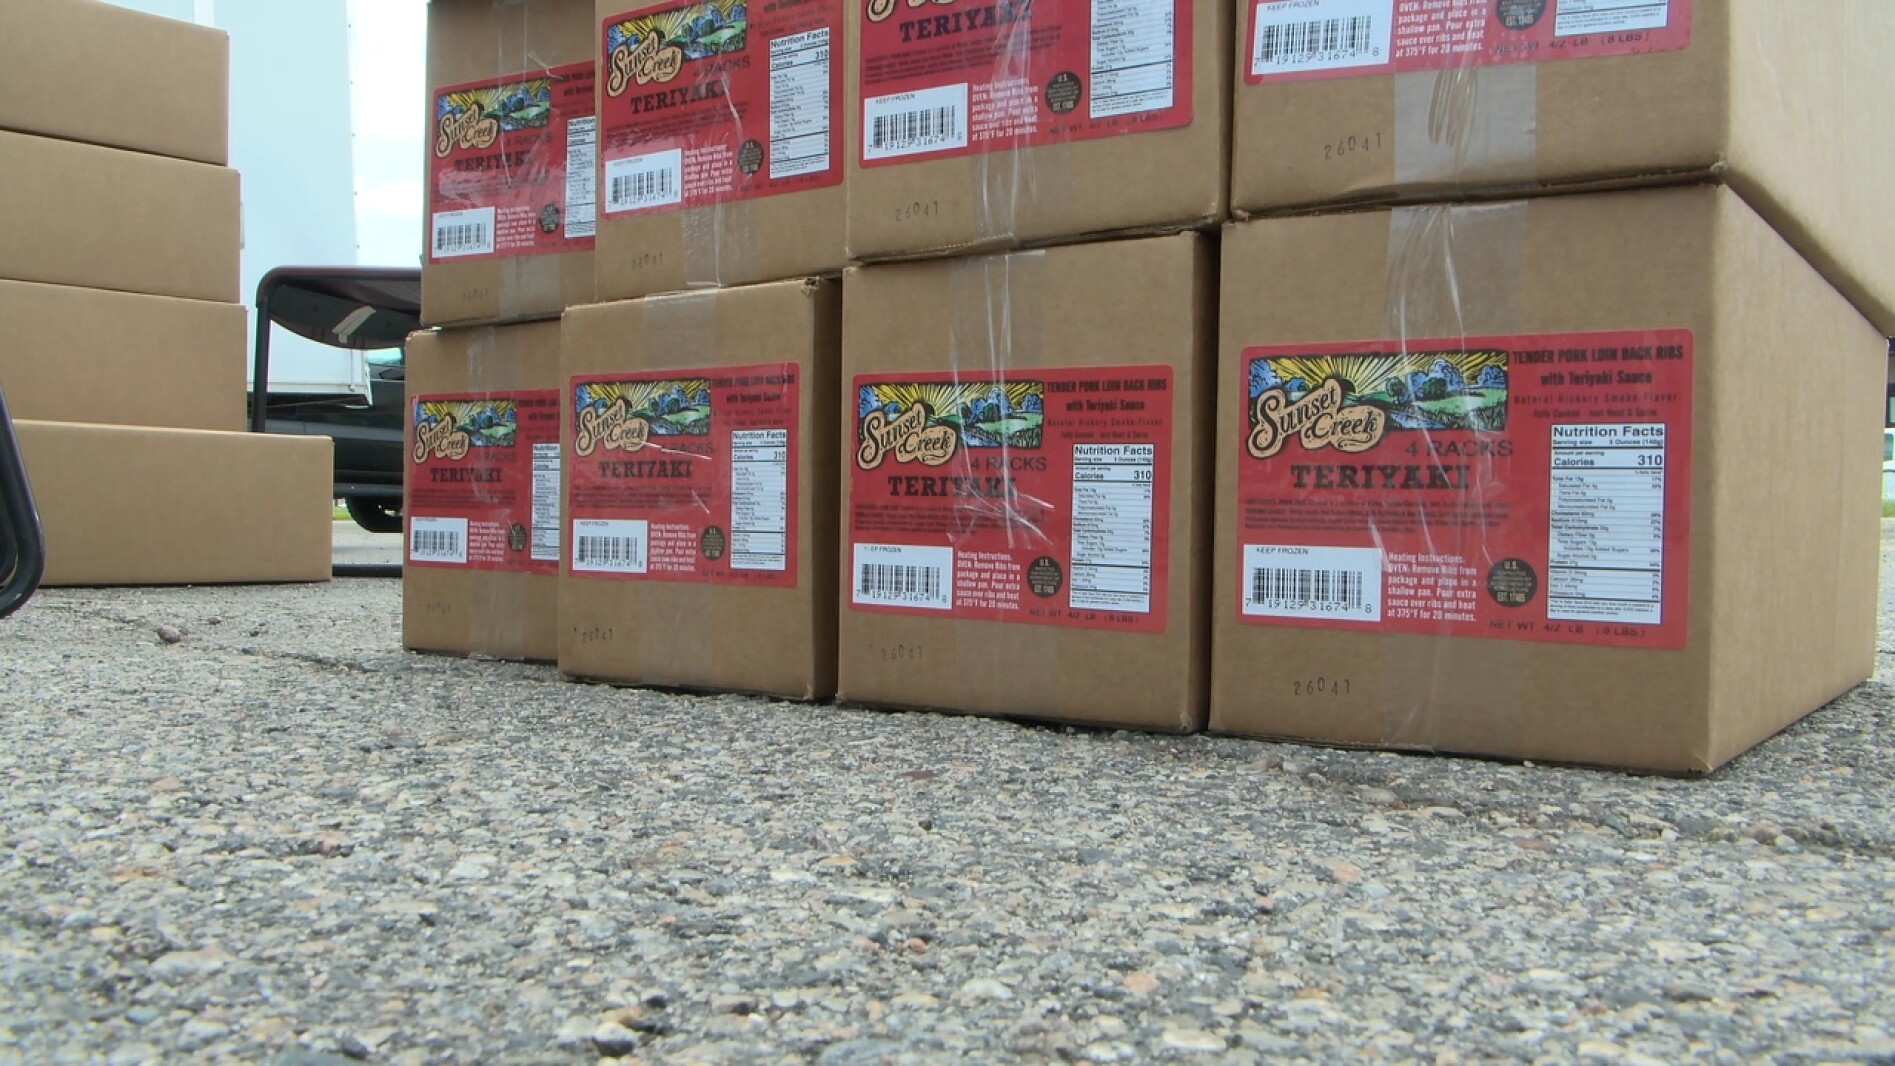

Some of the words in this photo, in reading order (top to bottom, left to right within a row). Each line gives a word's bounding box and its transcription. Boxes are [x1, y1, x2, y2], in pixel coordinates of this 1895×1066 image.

[1267, 3, 1287, 11] KEEP
[1289, 0, 1320, 9] FROZEN
[1398, 13, 1428, 25] package
[1431, 10, 1444, 20] and
[1447, 9, 1467, 20] place
[1398, 24, 1425, 35] shallow
[1445, 20, 1463, 31] Pour
[1465, 19, 1485, 29] extra
[771, 35, 805, 49] Nutrition
[807, 30, 828, 41] Facts
[1397, 36, 1417, 47] sauce
[1419, 35, 1434, 44] over
[1436, 33, 1450, 43] ribs
[1452, 30, 1465, 41] and
[1466, 29, 1484, 40] heat
[1573, 37, 1589, 47] LB
[1396, 48, 1403, 57] at
[1428, 45, 1439, 55] for
[1440, 43, 1450, 54] 20
[1452, 42, 1484, 53] minutes.
[609, 36, 658, 91] Sunset
[1277, 51, 1312, 65] 19129
[1318, 49, 1356, 62] 31674
[637, 52, 678, 80] Creek
[1513, 350, 1554, 365] TENDER
[1559, 349, 1588, 363] PORK
[1592, 348, 1619, 362] LOIN
[1622, 346, 1653, 361] BACK
[1656, 345, 1684, 359] RIBS
[1541, 372, 1565, 386] with
[1569, 370, 1613, 387] Teriyaki
[1617, 370, 1653, 384] Sauce
[1047, 381, 1077, 393] TENDER
[1079, 381, 1099, 392] PORK
[1102, 380, 1121, 392] LOIN
[1123, 379, 1145, 391] BACK
[1066, 401, 1083, 412] with
[1086, 400, 1117, 413] Teriyaki
[1120, 400, 1145, 411] Sauce
[1251, 385, 1336, 451] Sunset
[578, 405, 624, 451] Sunset
[1303, 409, 1378, 442] Creek
[1553, 426, 1617, 438] Nutrition
[1622, 425, 1664, 437] Facts
[606, 422, 646, 446] Creek
[733, 431, 765, 441] Nutrition
[766, 431, 786, 439] Facts
[863, 410, 924, 462] Sunset
[899, 432, 950, 458] Creek
[1405, 442, 1416, 457] 4
[1428, 439, 1513, 458] RACKS
[1553, 439, 1578, 447] Serving
[1075, 446, 1120, 456] Nutrition
[1123, 445, 1153, 456] Facts
[971, 458, 980, 471] 4
[986, 456, 1047, 472] RACKS
[1554, 458, 1595, 466] Calories
[1637, 454, 1663, 466] 310
[430, 467, 503, 483] TERIYAKI
[598, 460, 693, 479] TERIYAKI
[1075, 471, 1104, 480] Calories
[1133, 470, 1151, 480] 310
[1290, 463, 1470, 490] TERIYAKI
[1256, 547, 1275, 555] KEEP
[1277, 547, 1309, 556] FROZEN
[1388, 551, 1417, 564] Heating
[1411, 565, 1440, 575] Remove
[1441, 565, 1458, 575] Ribs
[1459, 566, 1477, 576] from
[1388, 575, 1418, 587] package
[1421, 576, 1435, 586] and
[1437, 577, 1458, 588] place
[1460, 577, 1469, 586] in
[872, 590, 898, 600] 19129
[902, 591, 931, 602] 31674
[1388, 586, 1415, 596] shallow
[1417, 588, 1433, 598] pan.
[1436, 588, 1454, 598] Pour
[1456, 589, 1477, 599] extra
[1268, 600, 1305, 610] 19129
[1309, 600, 1349, 612] 31674
[1364, 603, 1373, 614] 8
[1388, 597, 1409, 607] sauce
[1410, 599, 1427, 608] over
[1427, 599, 1442, 609] ribs
[1443, 599, 1457, 609] and
[1457, 600, 1476, 611] heat
[1386, 608, 1395, 618] at
[1396, 608, 1419, 619] 375°F
[1419, 609, 1431, 619] for
[1432, 610, 1443, 620] 20
[1444, 610, 1477, 622] minutes.
[1490, 620, 1512, 629] NET
[1517, 621, 1536, 631] WT
[1544, 623, 1561, 633] 4/2
[1568, 624, 1584, 634] LB
